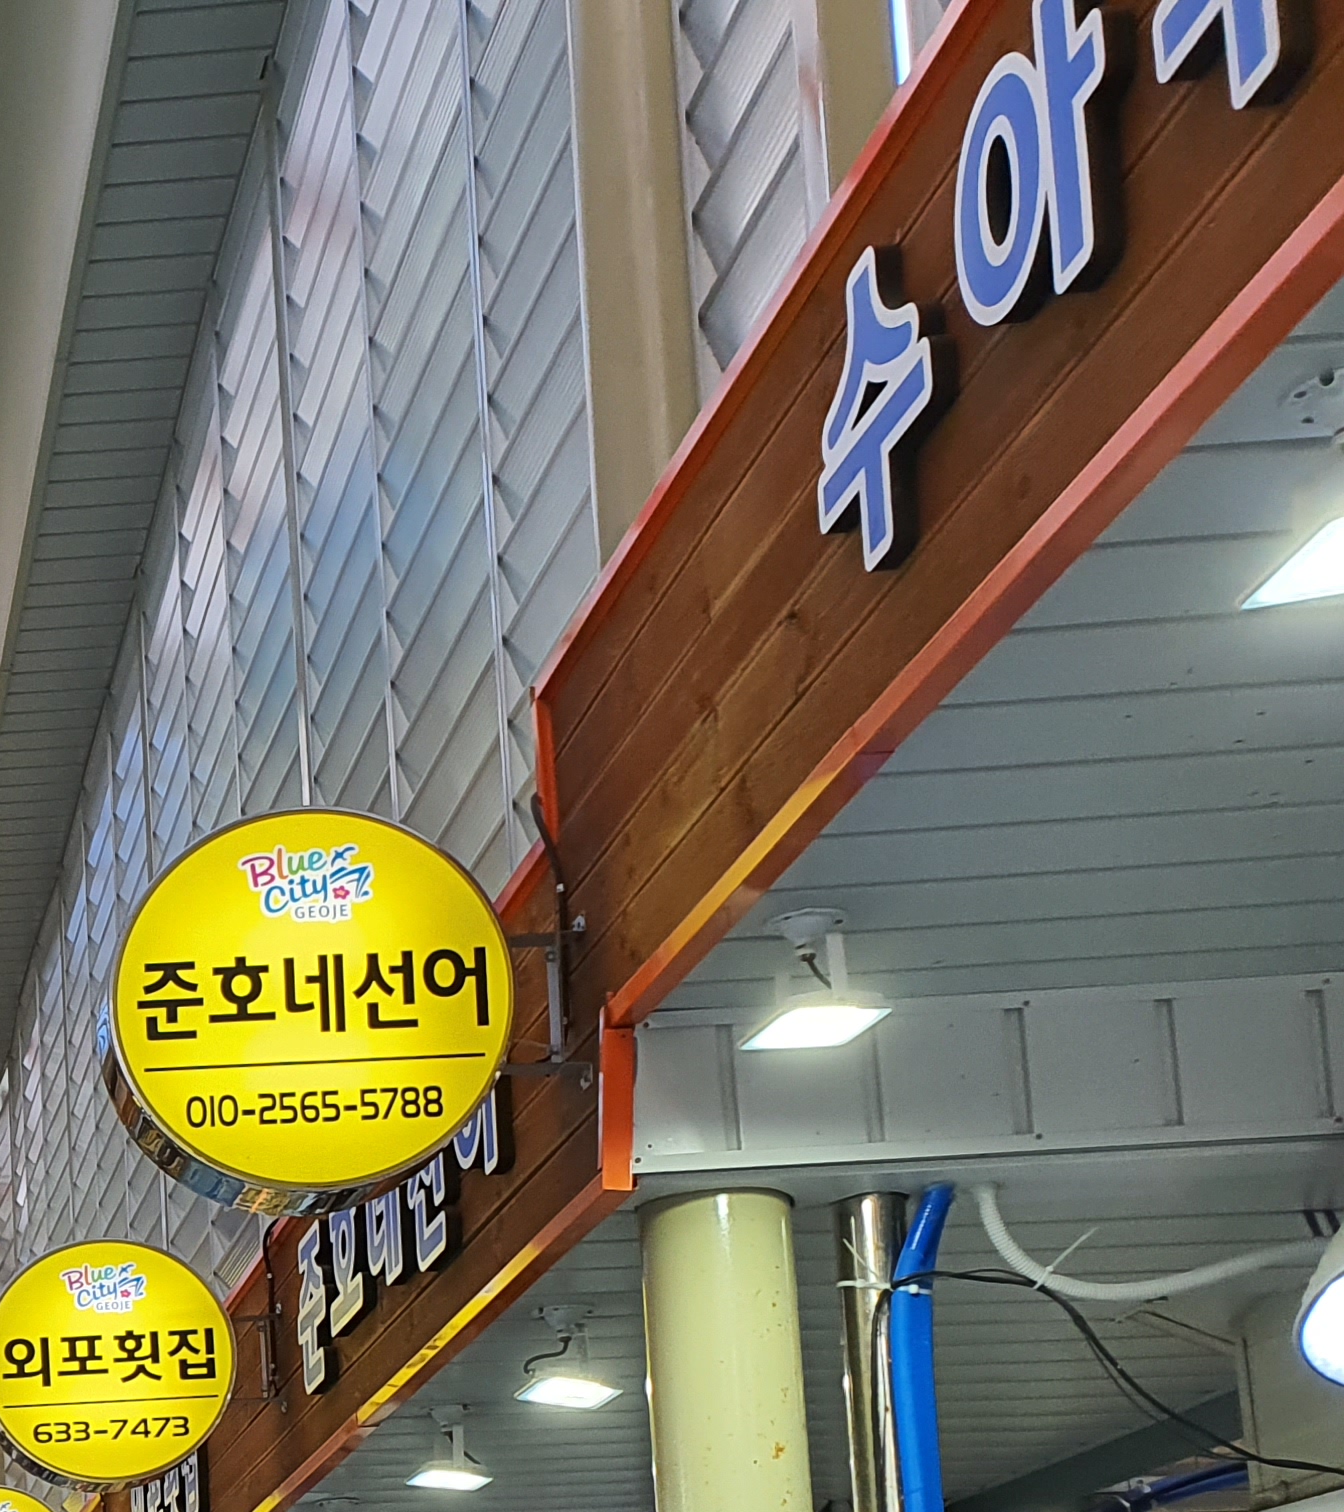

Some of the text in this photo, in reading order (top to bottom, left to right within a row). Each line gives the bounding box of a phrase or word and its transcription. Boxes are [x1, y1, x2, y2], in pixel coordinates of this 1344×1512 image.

[241, 847, 328, 889] Blue
[263, 877, 330, 913] City
[294, 904, 349, 920] GEOJE
[137, 947, 490, 1041] 준호네선어
[185, 1085, 444, 1128] 010-2565-5788
[61, 1266, 117, 1293] Blue
[77, 1283, 119, 1308] City
[96, 1301, 132, 1311] GEOJE
[2, 1328, 217, 1387] 외포횟집
[32, 1416, 191, 1444] 633-7473
